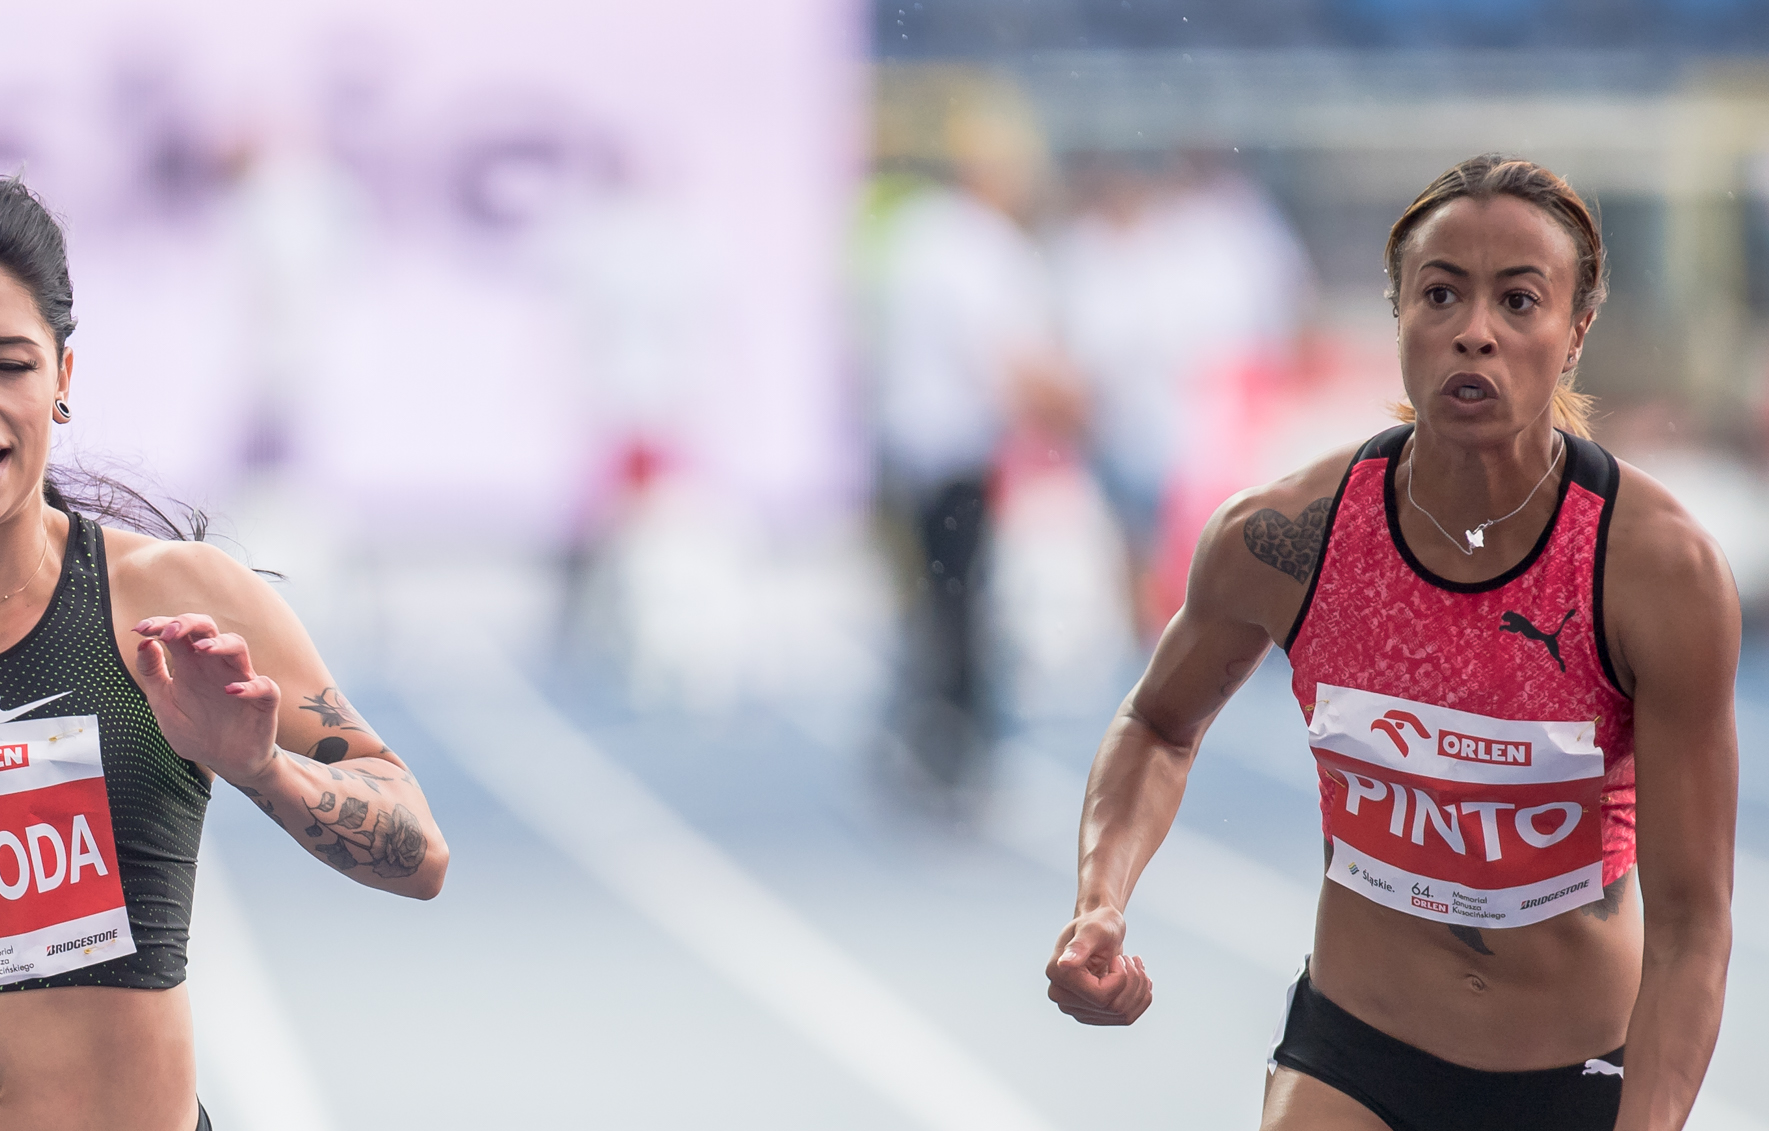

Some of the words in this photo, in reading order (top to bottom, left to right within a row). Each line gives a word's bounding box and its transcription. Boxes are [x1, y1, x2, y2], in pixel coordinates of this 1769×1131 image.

[1442, 734, 1526, 764] ORLEN
[1335, 768, 1583, 863] PINTO
[1413, 898, 1447, 913] ORLEN
[1451, 898, 1482, 911] Janusza
[1519, 879, 1591, 911] BRIDGESTONE
[46, 928, 118, 957] BRIDGESTONE
